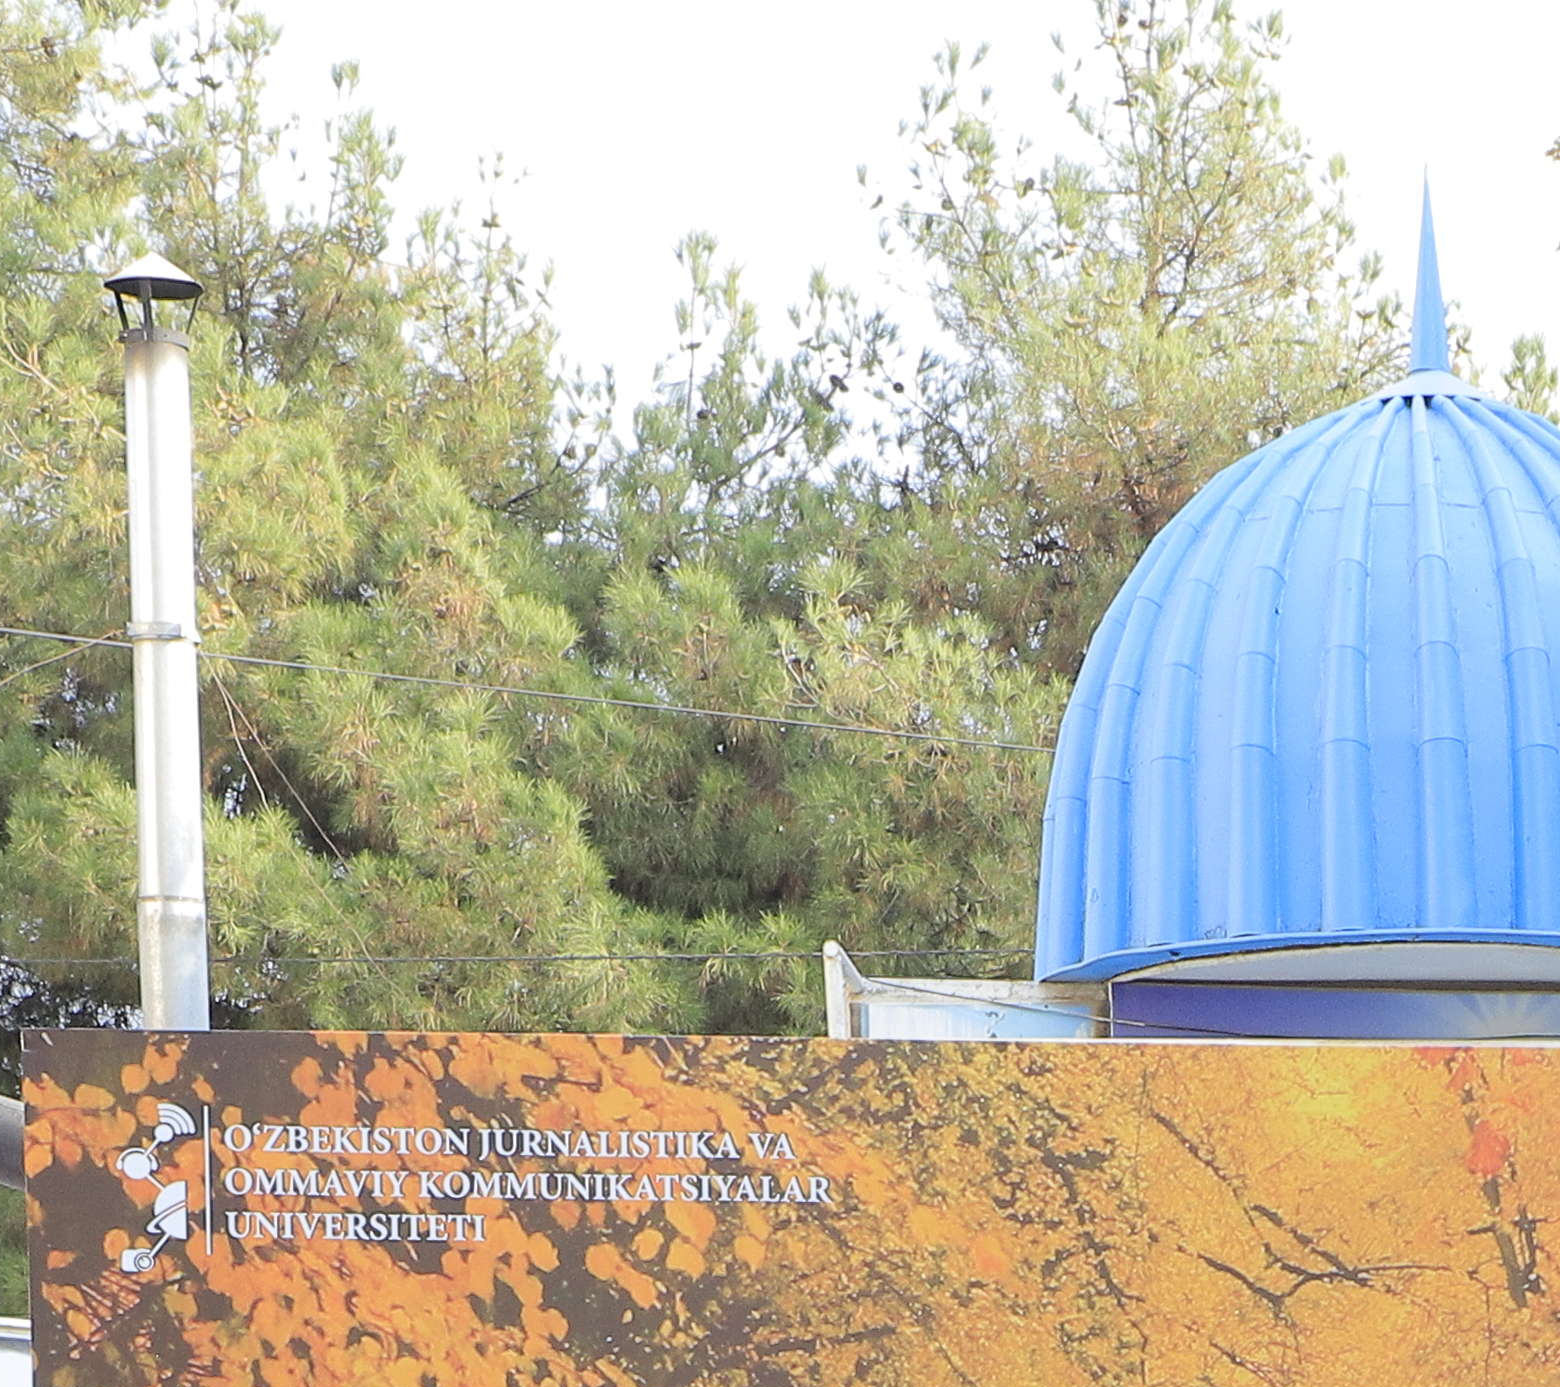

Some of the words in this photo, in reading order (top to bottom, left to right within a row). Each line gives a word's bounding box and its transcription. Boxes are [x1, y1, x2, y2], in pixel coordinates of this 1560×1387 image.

[223, 1123, 471, 1156] O‘ZBEKISTON
[478, 1128, 741, 1161] JURNALISTIKA
[748, 1132, 797, 1160] VA
[224, 1167, 410, 1199] OMMAVIY
[418, 1170, 834, 1204] KOMMUNIKATSIYALAR
[224, 1210, 486, 1242] UNIVERSITETI
